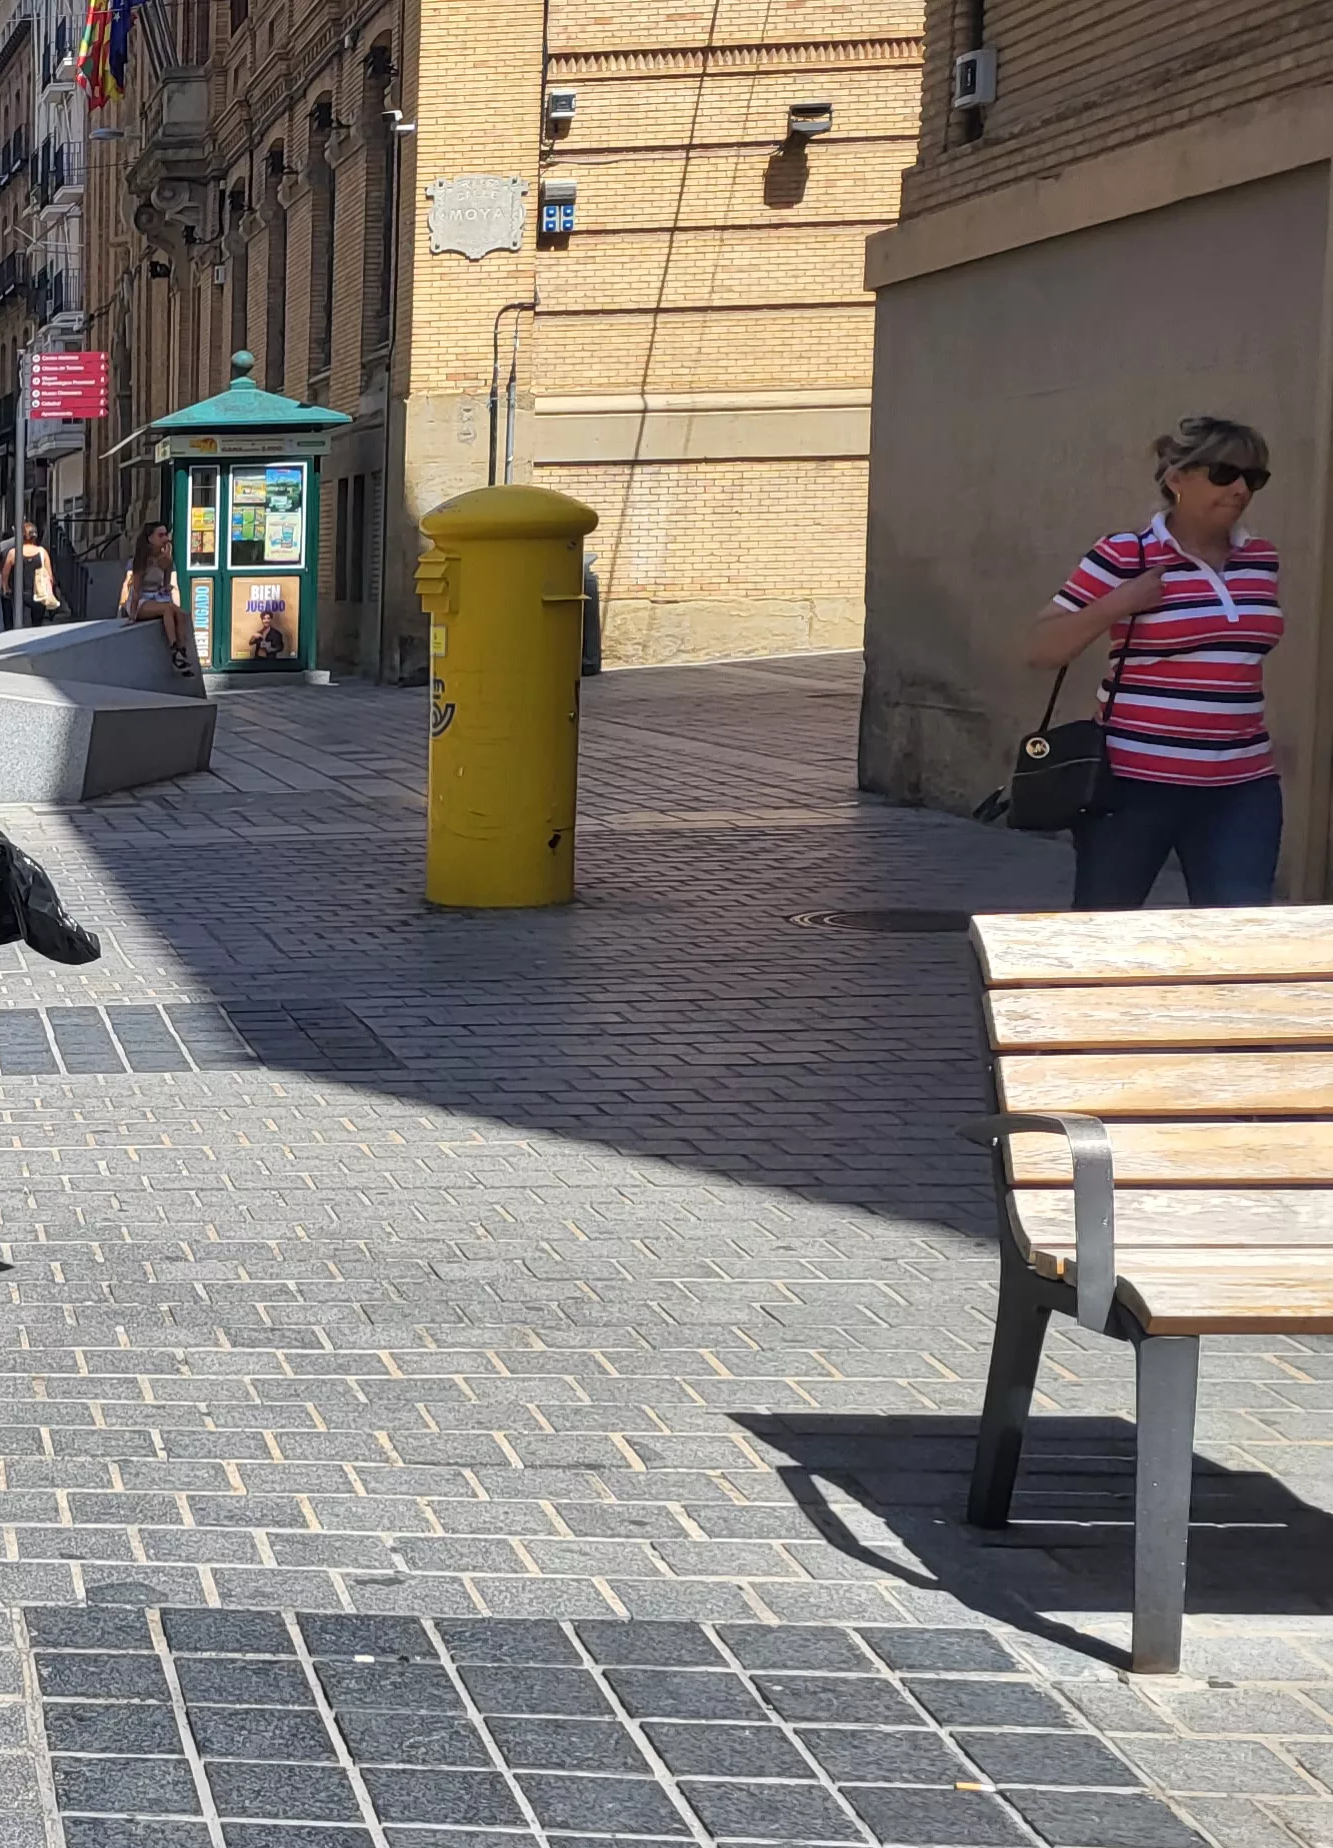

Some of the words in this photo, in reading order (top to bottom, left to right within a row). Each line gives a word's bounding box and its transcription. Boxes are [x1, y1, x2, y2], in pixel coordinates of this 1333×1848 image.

[450, 206, 506, 221] MOYA
[250, 584, 281, 600] BIEN
[195, 586, 210, 630] JUGADO
[245, 600, 286, 612] JUGADO
